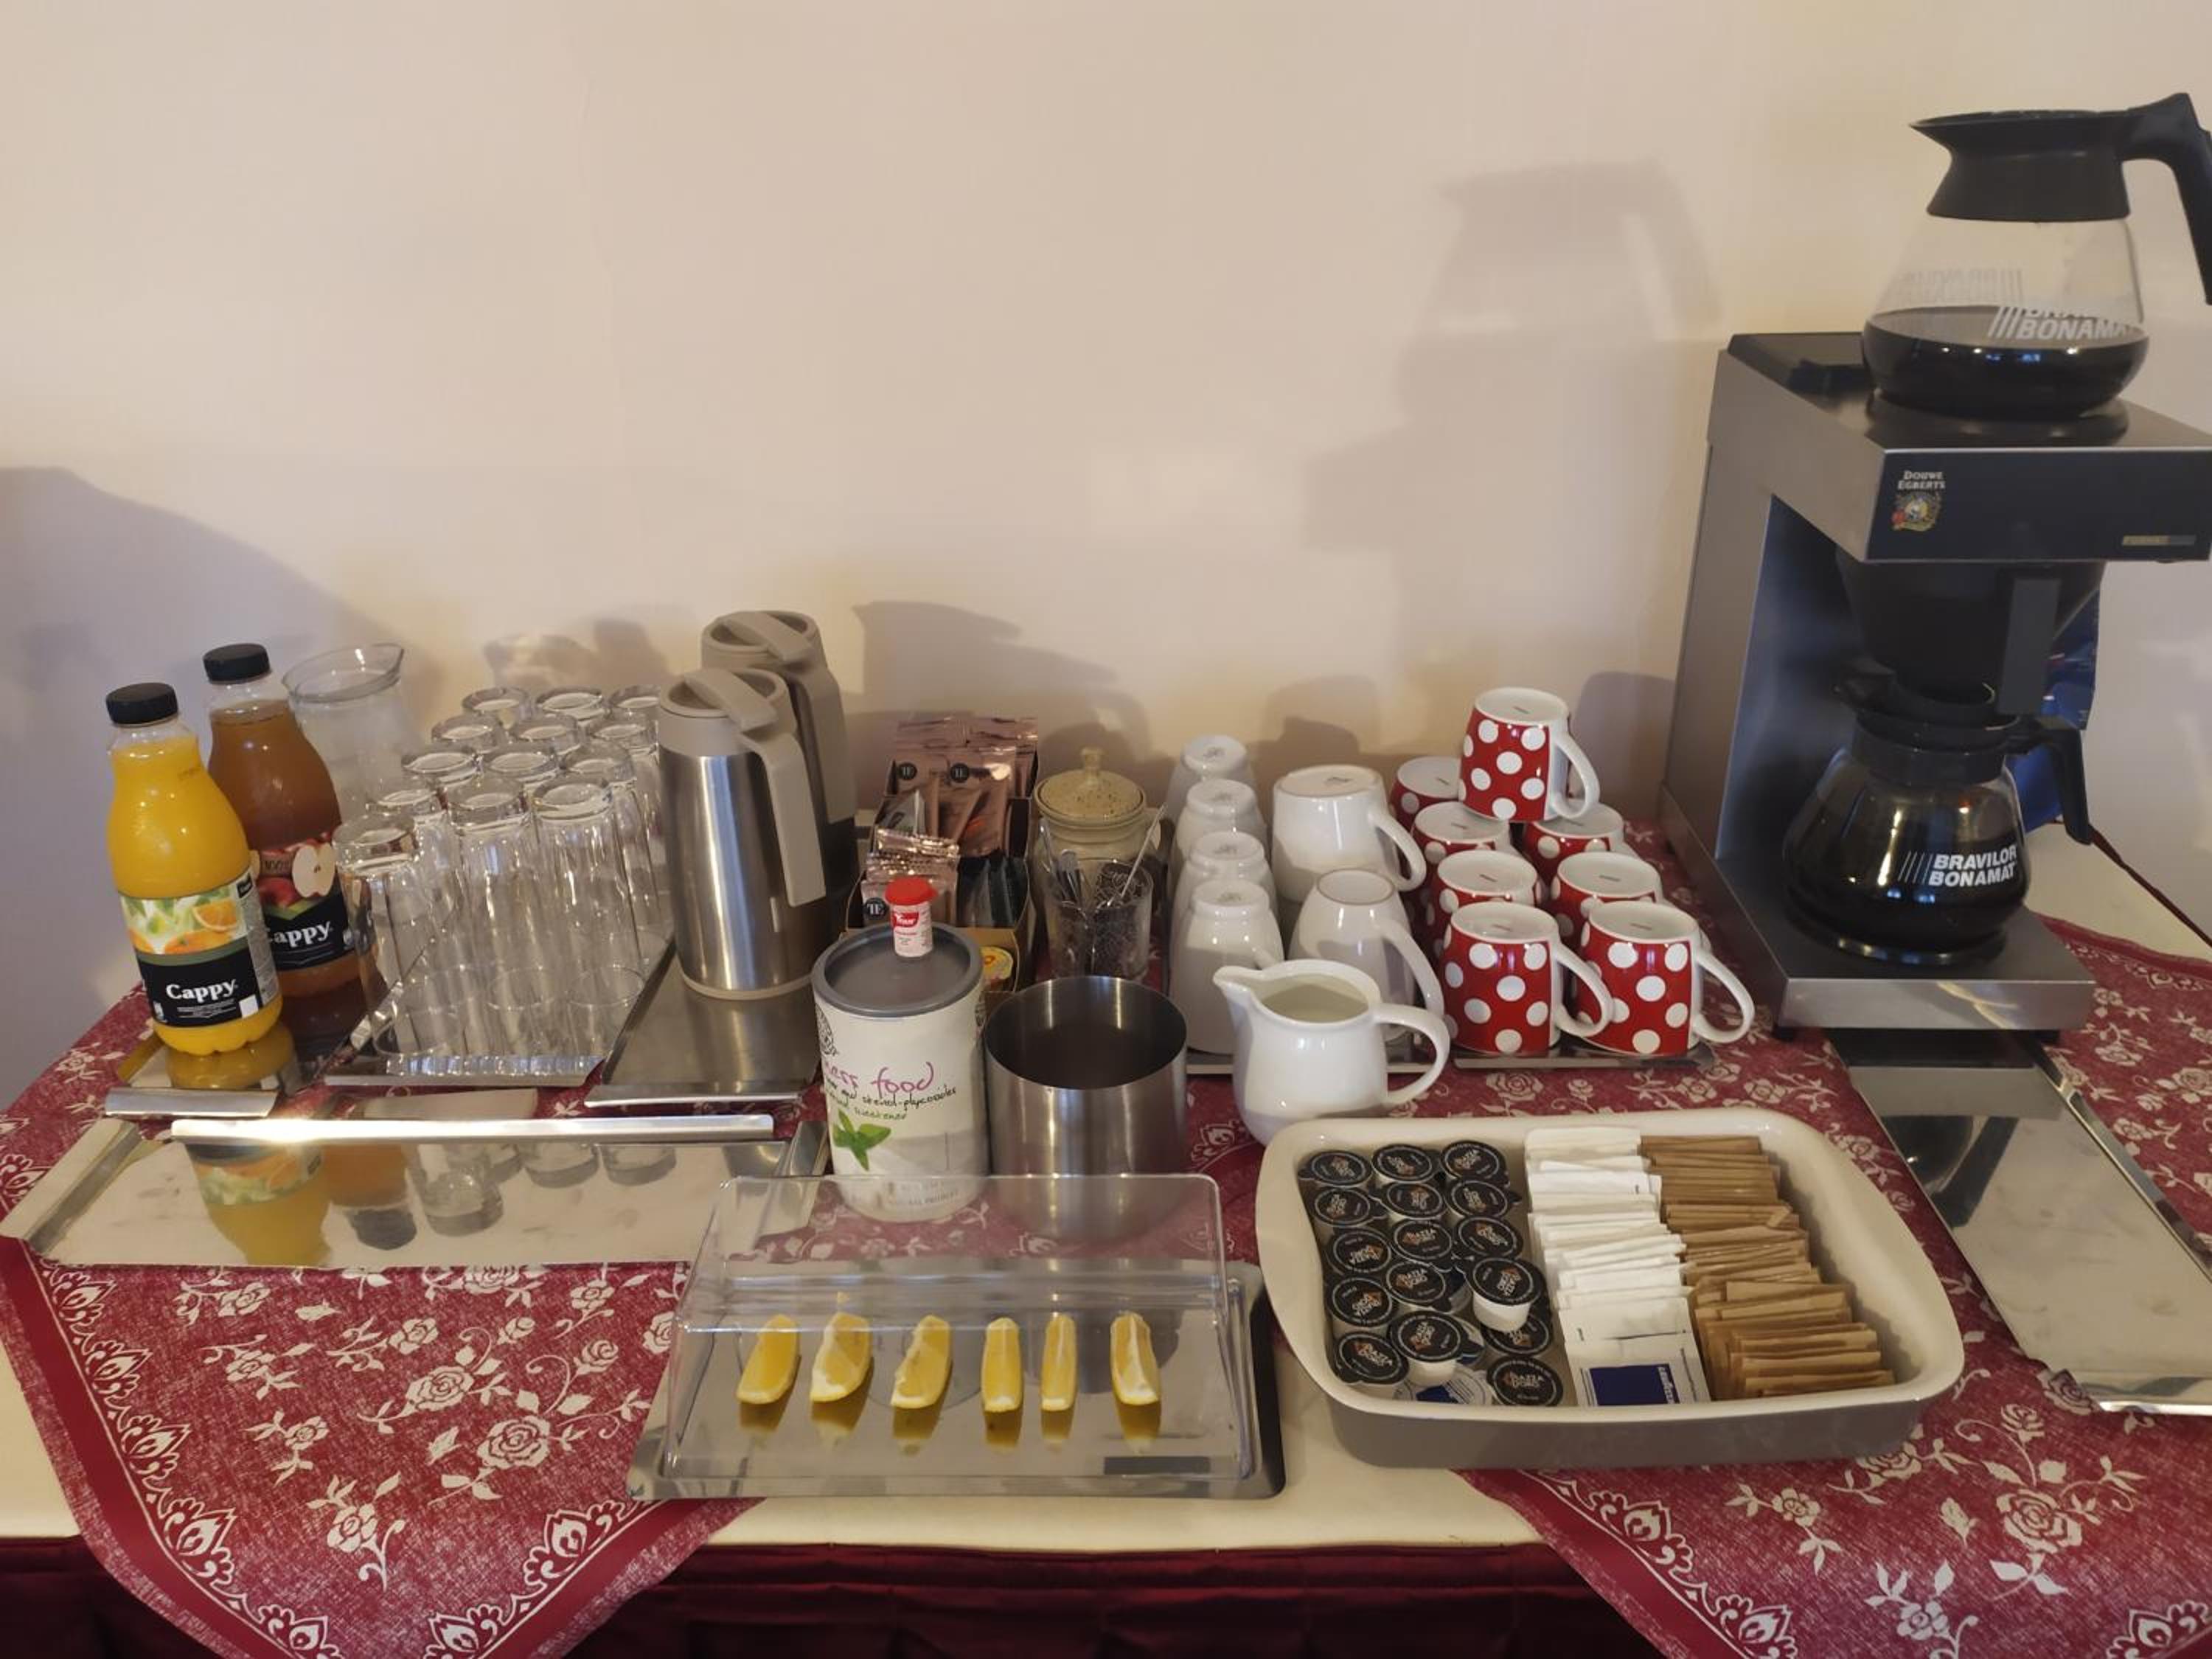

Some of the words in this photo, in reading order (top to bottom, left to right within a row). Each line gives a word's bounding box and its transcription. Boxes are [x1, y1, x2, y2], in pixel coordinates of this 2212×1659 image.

[1933, 845, 2017, 870] BRAVILOR
[1928, 862, 2016, 887] BONAMAT
[268, 921, 331, 947] appy
[165, 978, 237, 1004] Cappy
[871, 1061, 934, 1099] food
